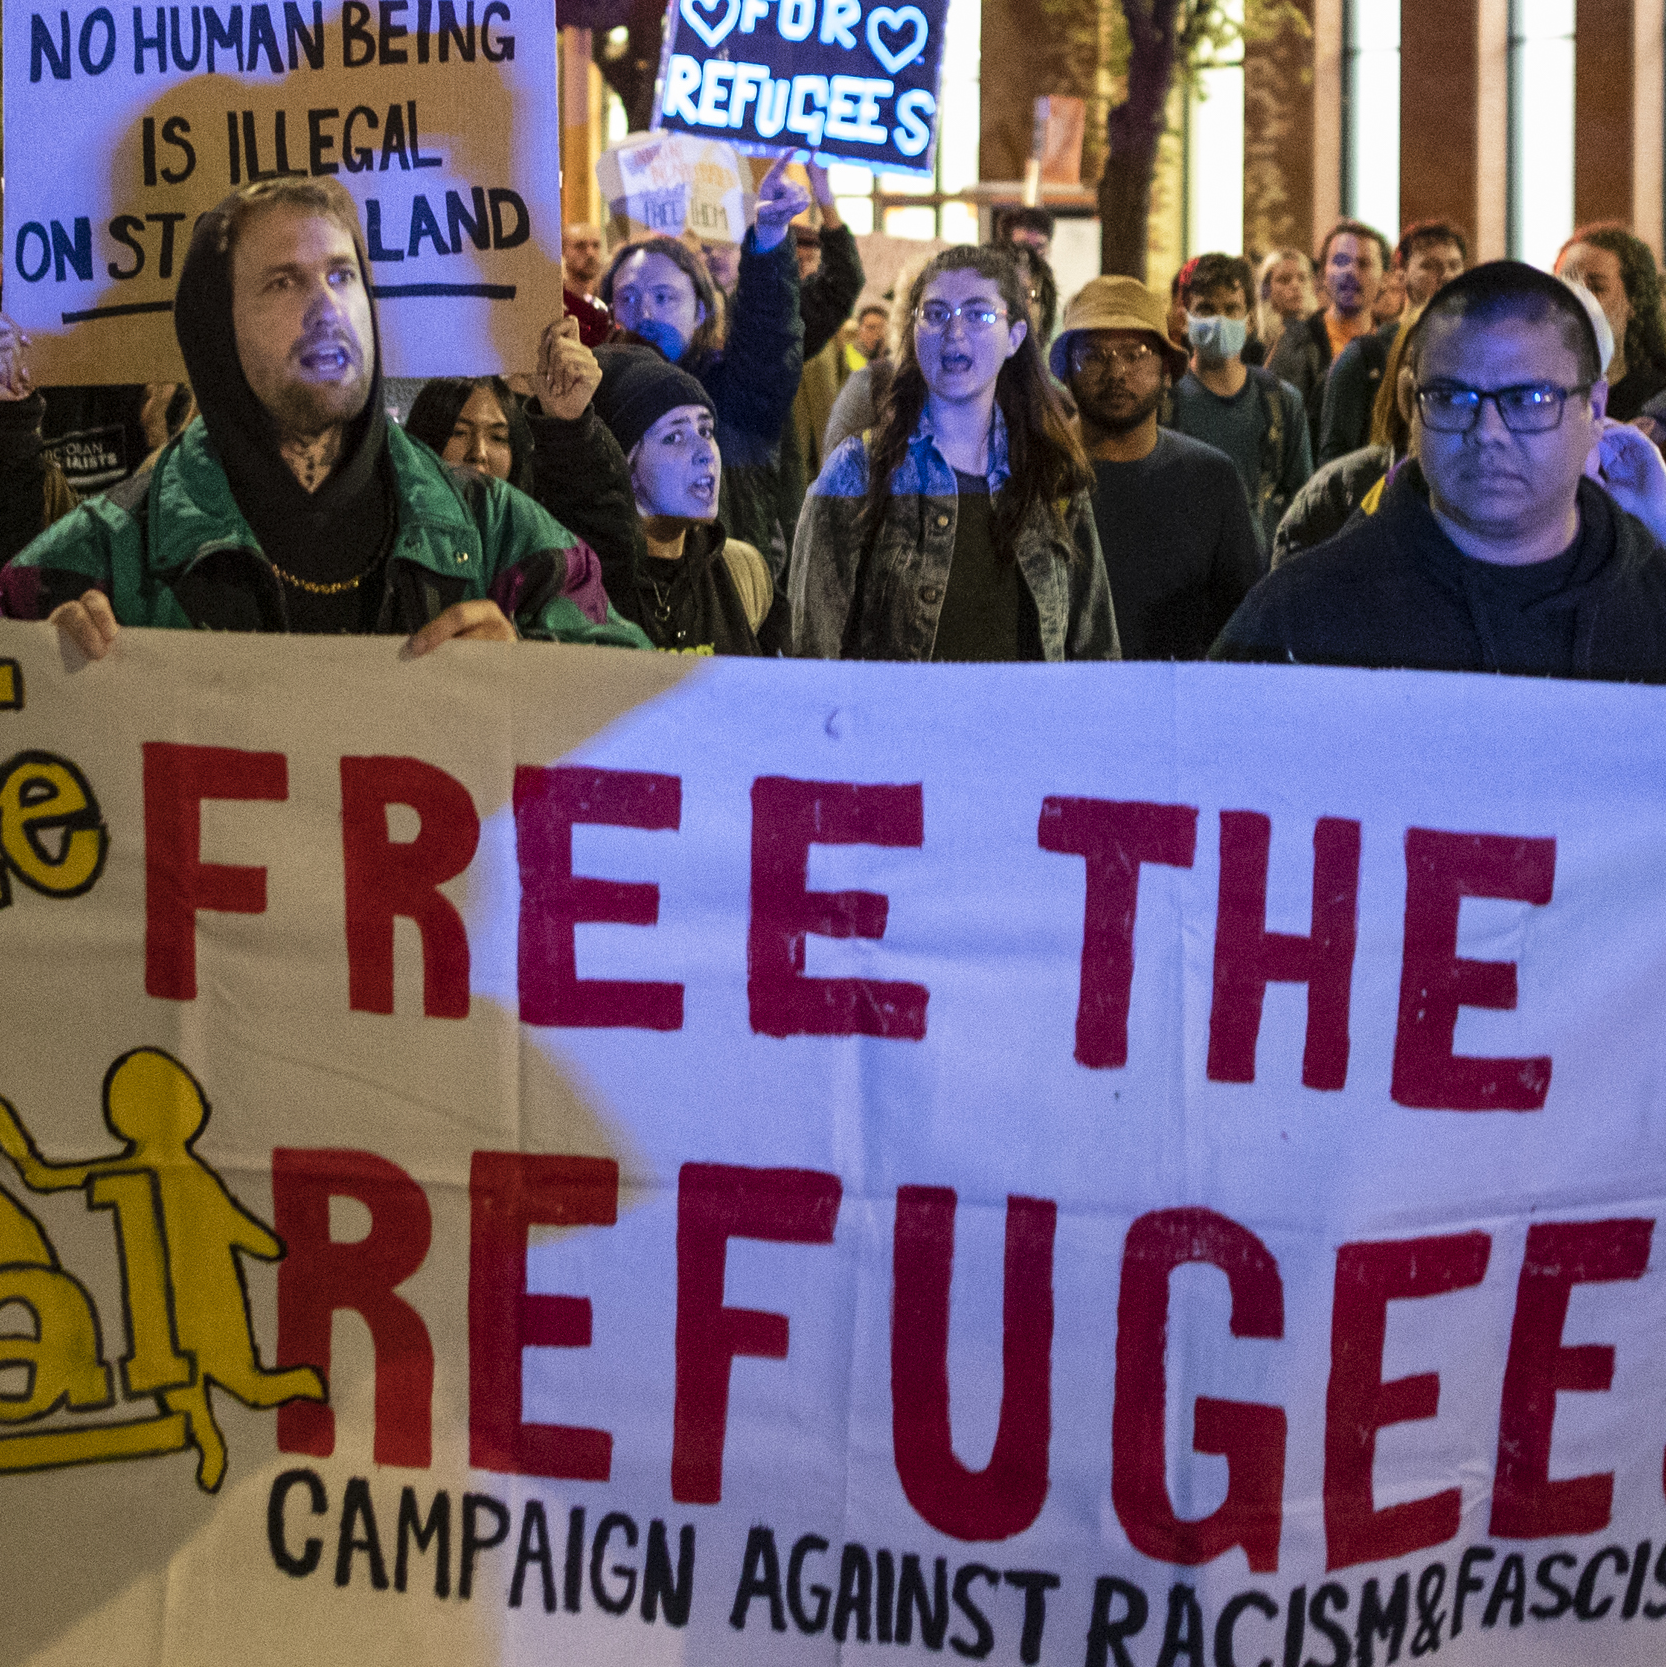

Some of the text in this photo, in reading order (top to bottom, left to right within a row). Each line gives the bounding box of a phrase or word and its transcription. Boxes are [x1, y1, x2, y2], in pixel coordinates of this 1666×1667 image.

[29, 0, 516, 83] NO HUMAN BEING
[142, 100, 443, 186] IS ILLEGAL
[662, 54, 937, 156] REFUGEES
[15, 216, 93, 283] ON
[365, 186, 530, 262] LAND
[143, 741, 1557, 1113] FREE THE
[267, 1468, 697, 1628] CAMPAIGN
[729, 1523, 1061, 1666] AGAINST
